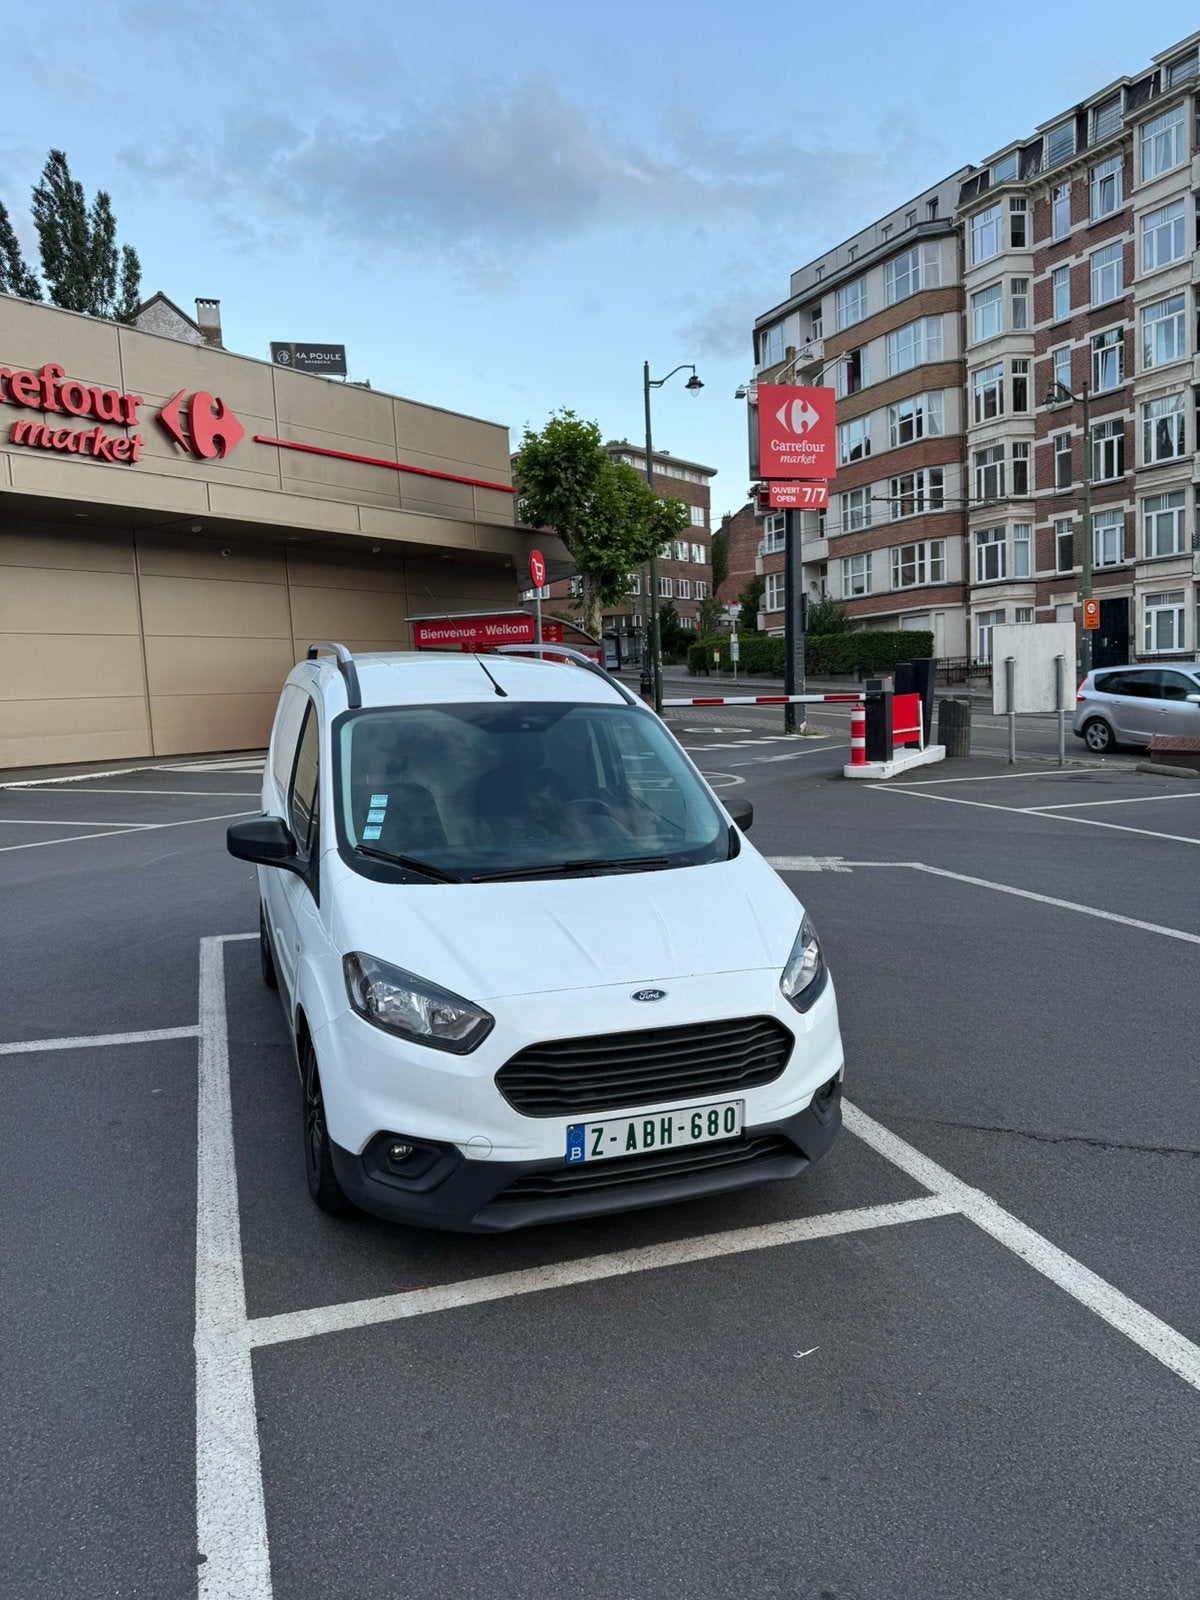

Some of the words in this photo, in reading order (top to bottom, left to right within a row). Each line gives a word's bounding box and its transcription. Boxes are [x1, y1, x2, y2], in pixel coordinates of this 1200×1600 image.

[310, 352, 342, 361] POULE
[9, 420, 145, 463] market
[771, 439, 825, 453] Carrefour
[780, 453, 816, 464] market
[772, 486, 800, 494] OUVERT
[776, 495, 796, 503] OPEN
[802, 487, 826, 503] 7/7
[420, 627, 476, 640] Bienvenue
[485, 623, 529, 636] Welkom
[639, 990, 660, 1000] Ford
[571, 1147, 582, 1159] B
